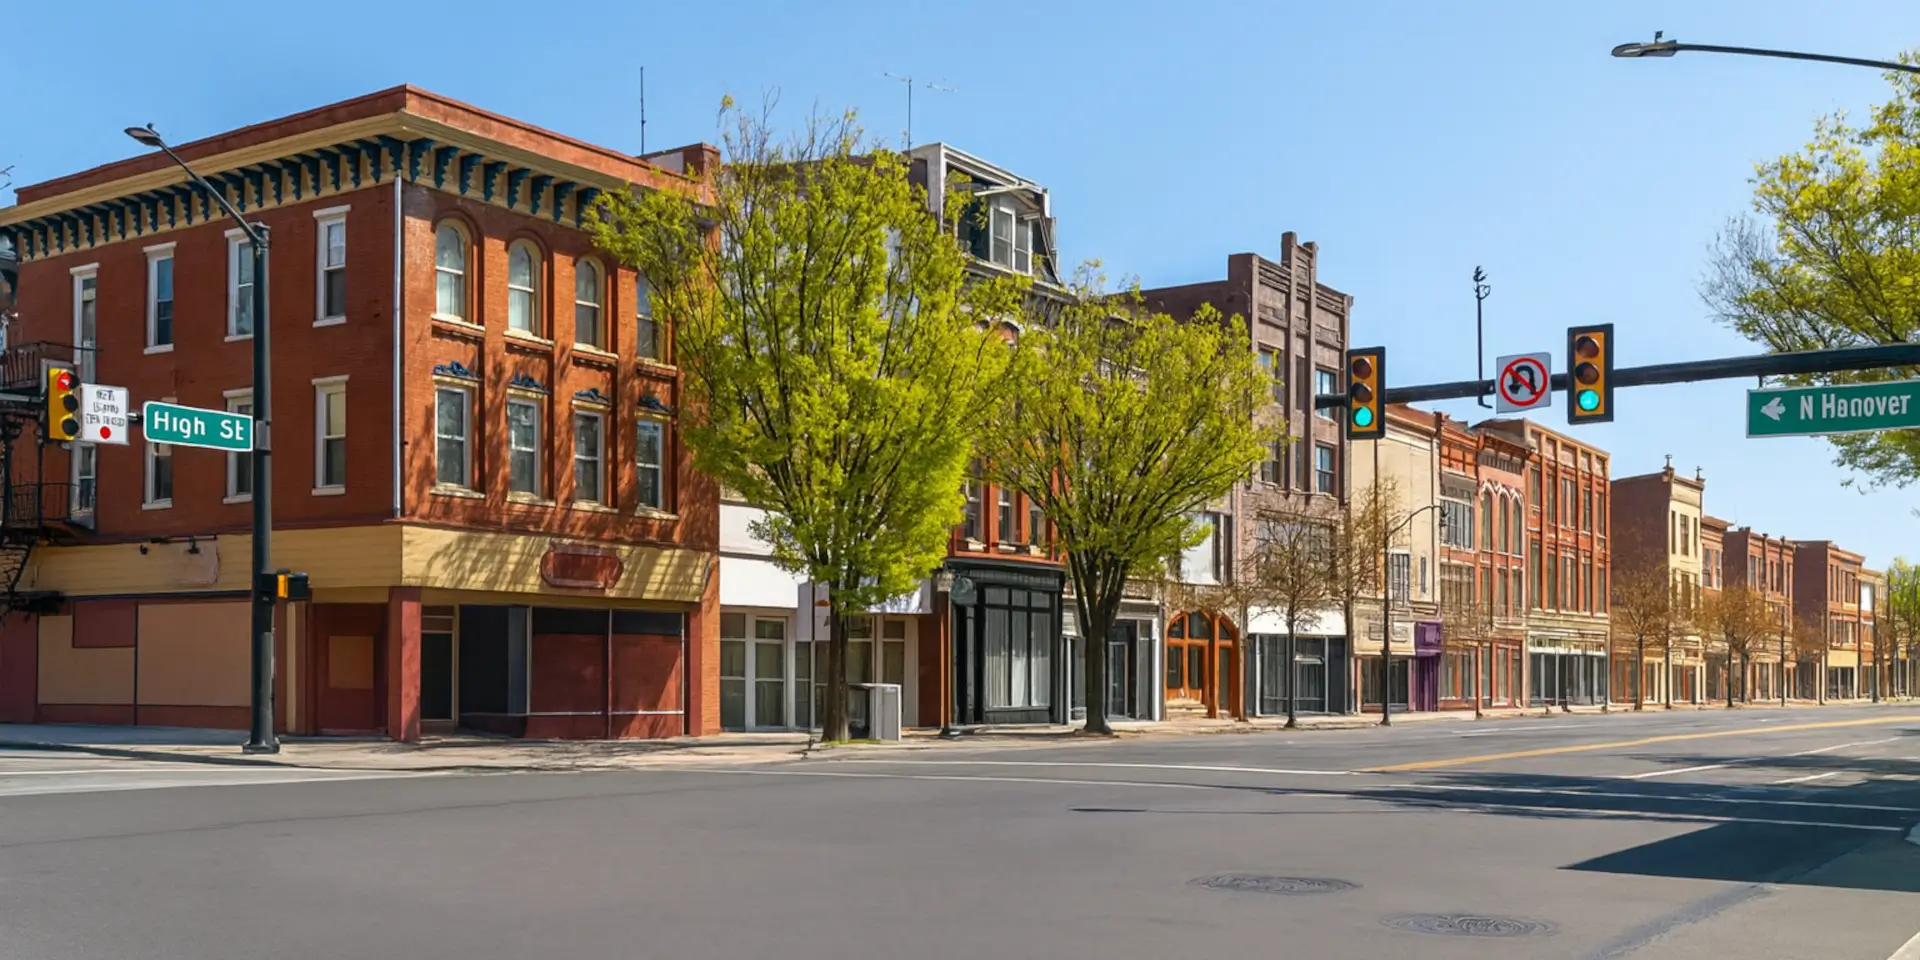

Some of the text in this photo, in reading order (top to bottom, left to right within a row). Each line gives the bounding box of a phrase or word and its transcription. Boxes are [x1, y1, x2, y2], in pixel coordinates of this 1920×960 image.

[1800, 393, 1911, 420] N Hanover
[154, 410, 206, 439] High
[220, 419, 244, 440] St
